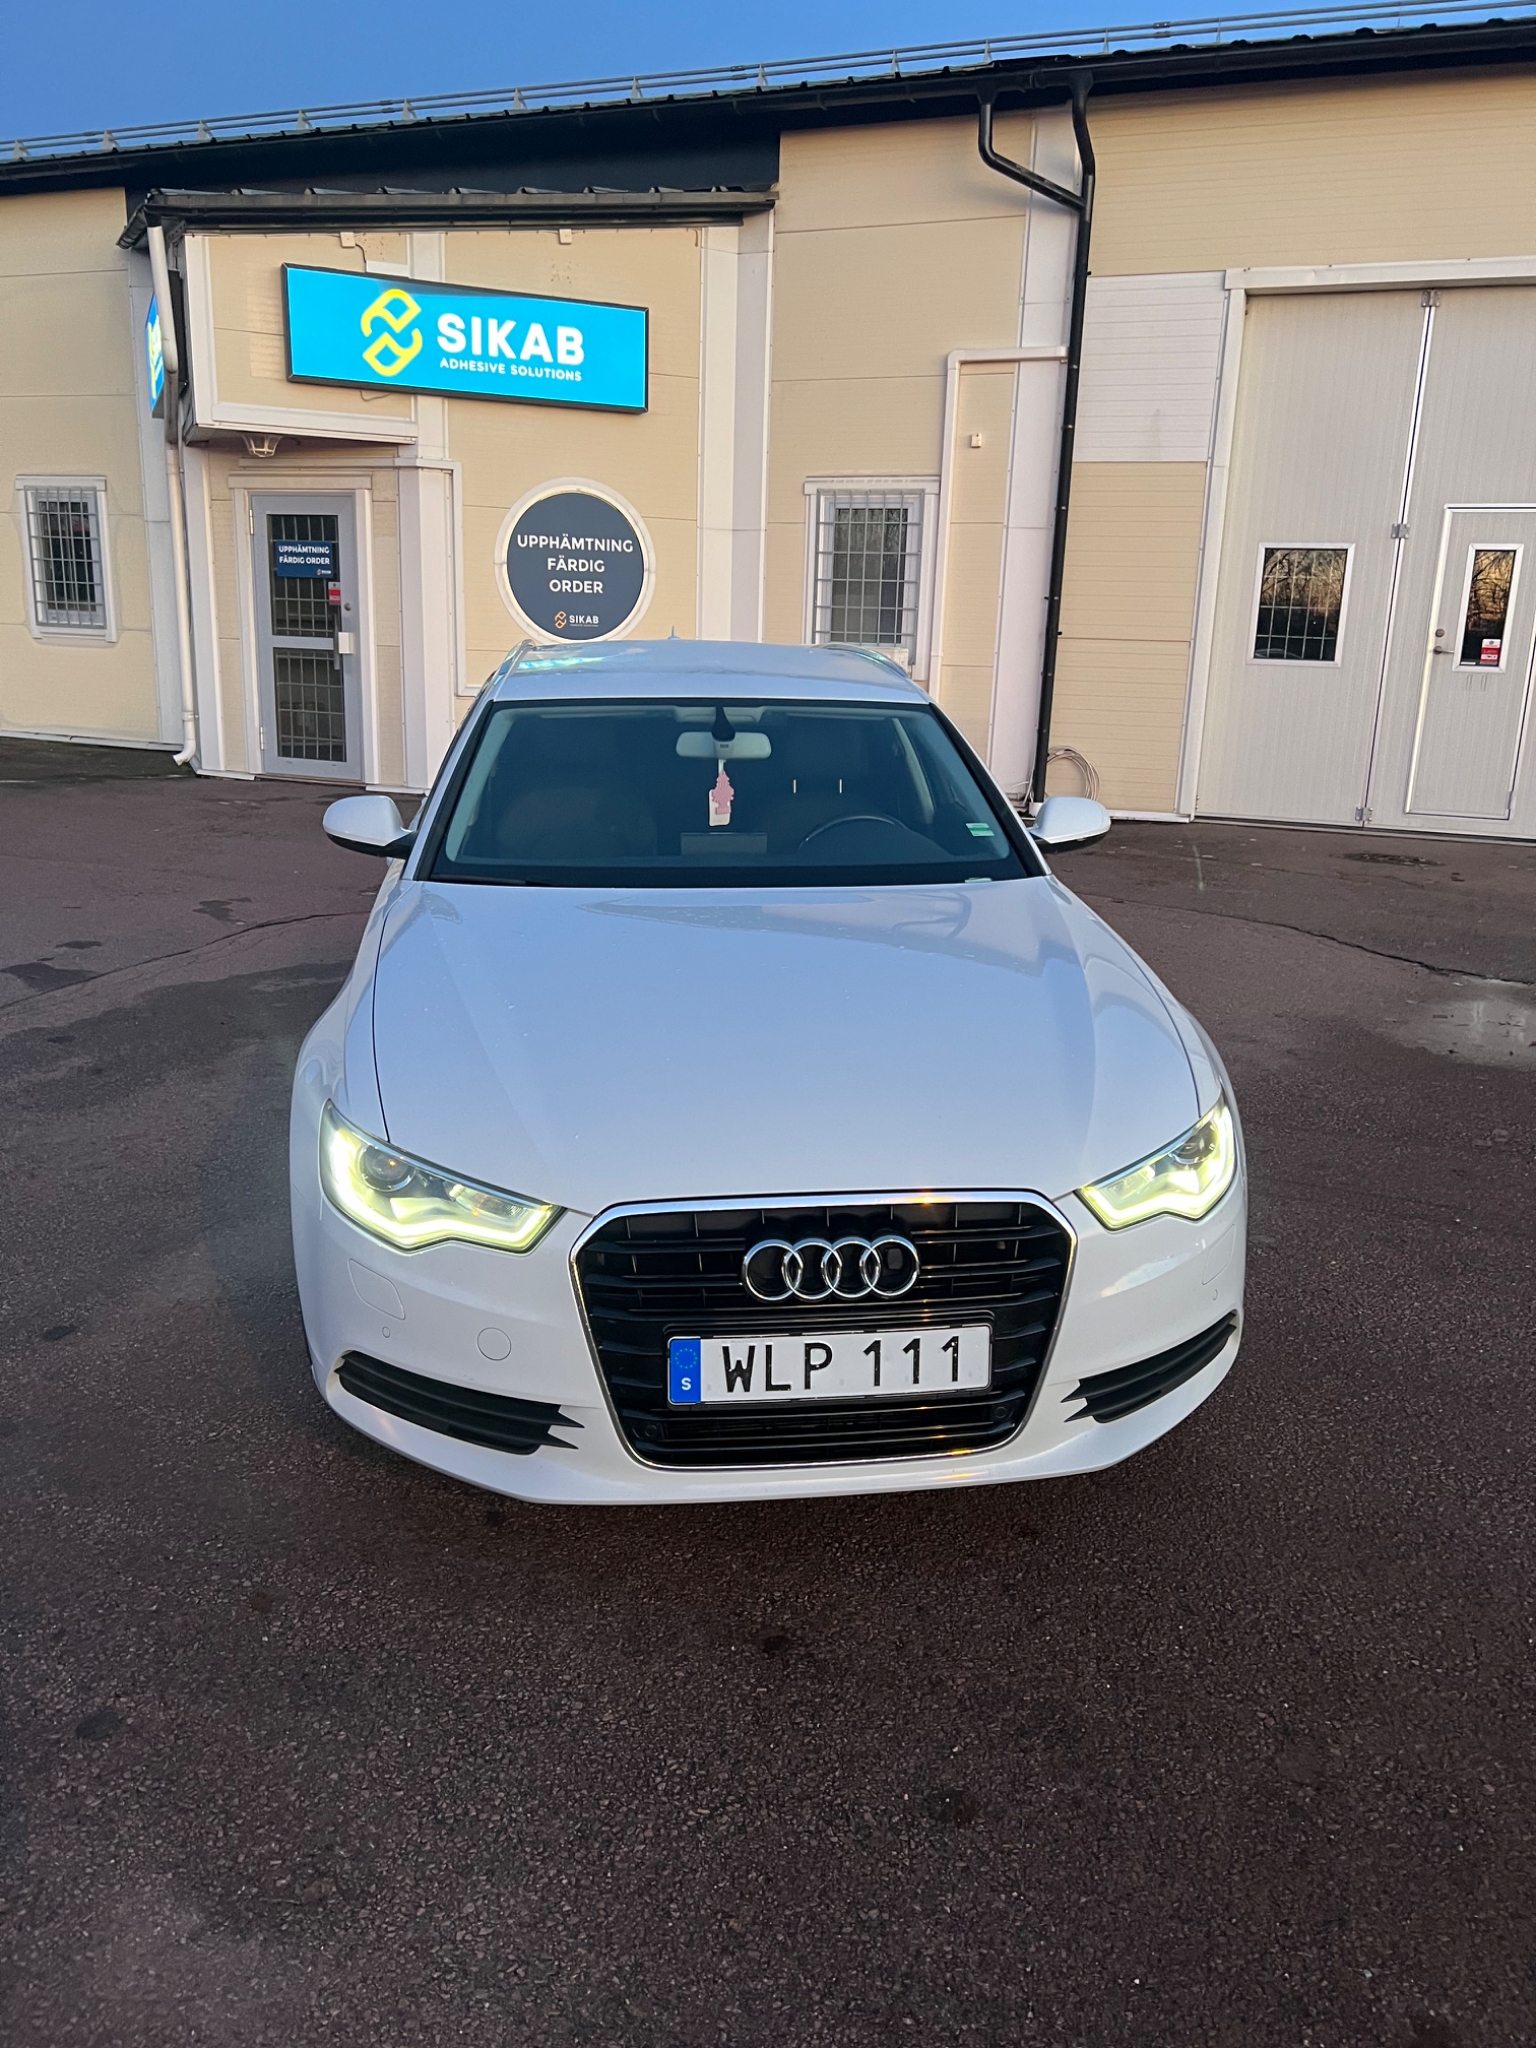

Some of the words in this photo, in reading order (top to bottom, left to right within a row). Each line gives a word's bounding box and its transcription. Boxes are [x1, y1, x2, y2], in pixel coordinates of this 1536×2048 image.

[437, 312, 585, 366] SIKAB
[439, 357, 506, 375] ADHESIVE
[510, 364, 582, 382] SOLUTIONS
[278, 545, 330, 554] UPPHÄMTNING
[517, 533, 634, 553] UPPHÄMTNING
[279, 555, 305, 564] FÄRDIG
[305, 556, 330, 565] ORDER
[547, 555, 605, 572] FÄRDIG
[549, 579, 604, 594] ORDER
[569, 614, 599, 624] SIKAB
[721, 1342, 833, 1393] WLP
[862, 1335, 960, 1387] 111
[681, 1377, 692, 1391] S
